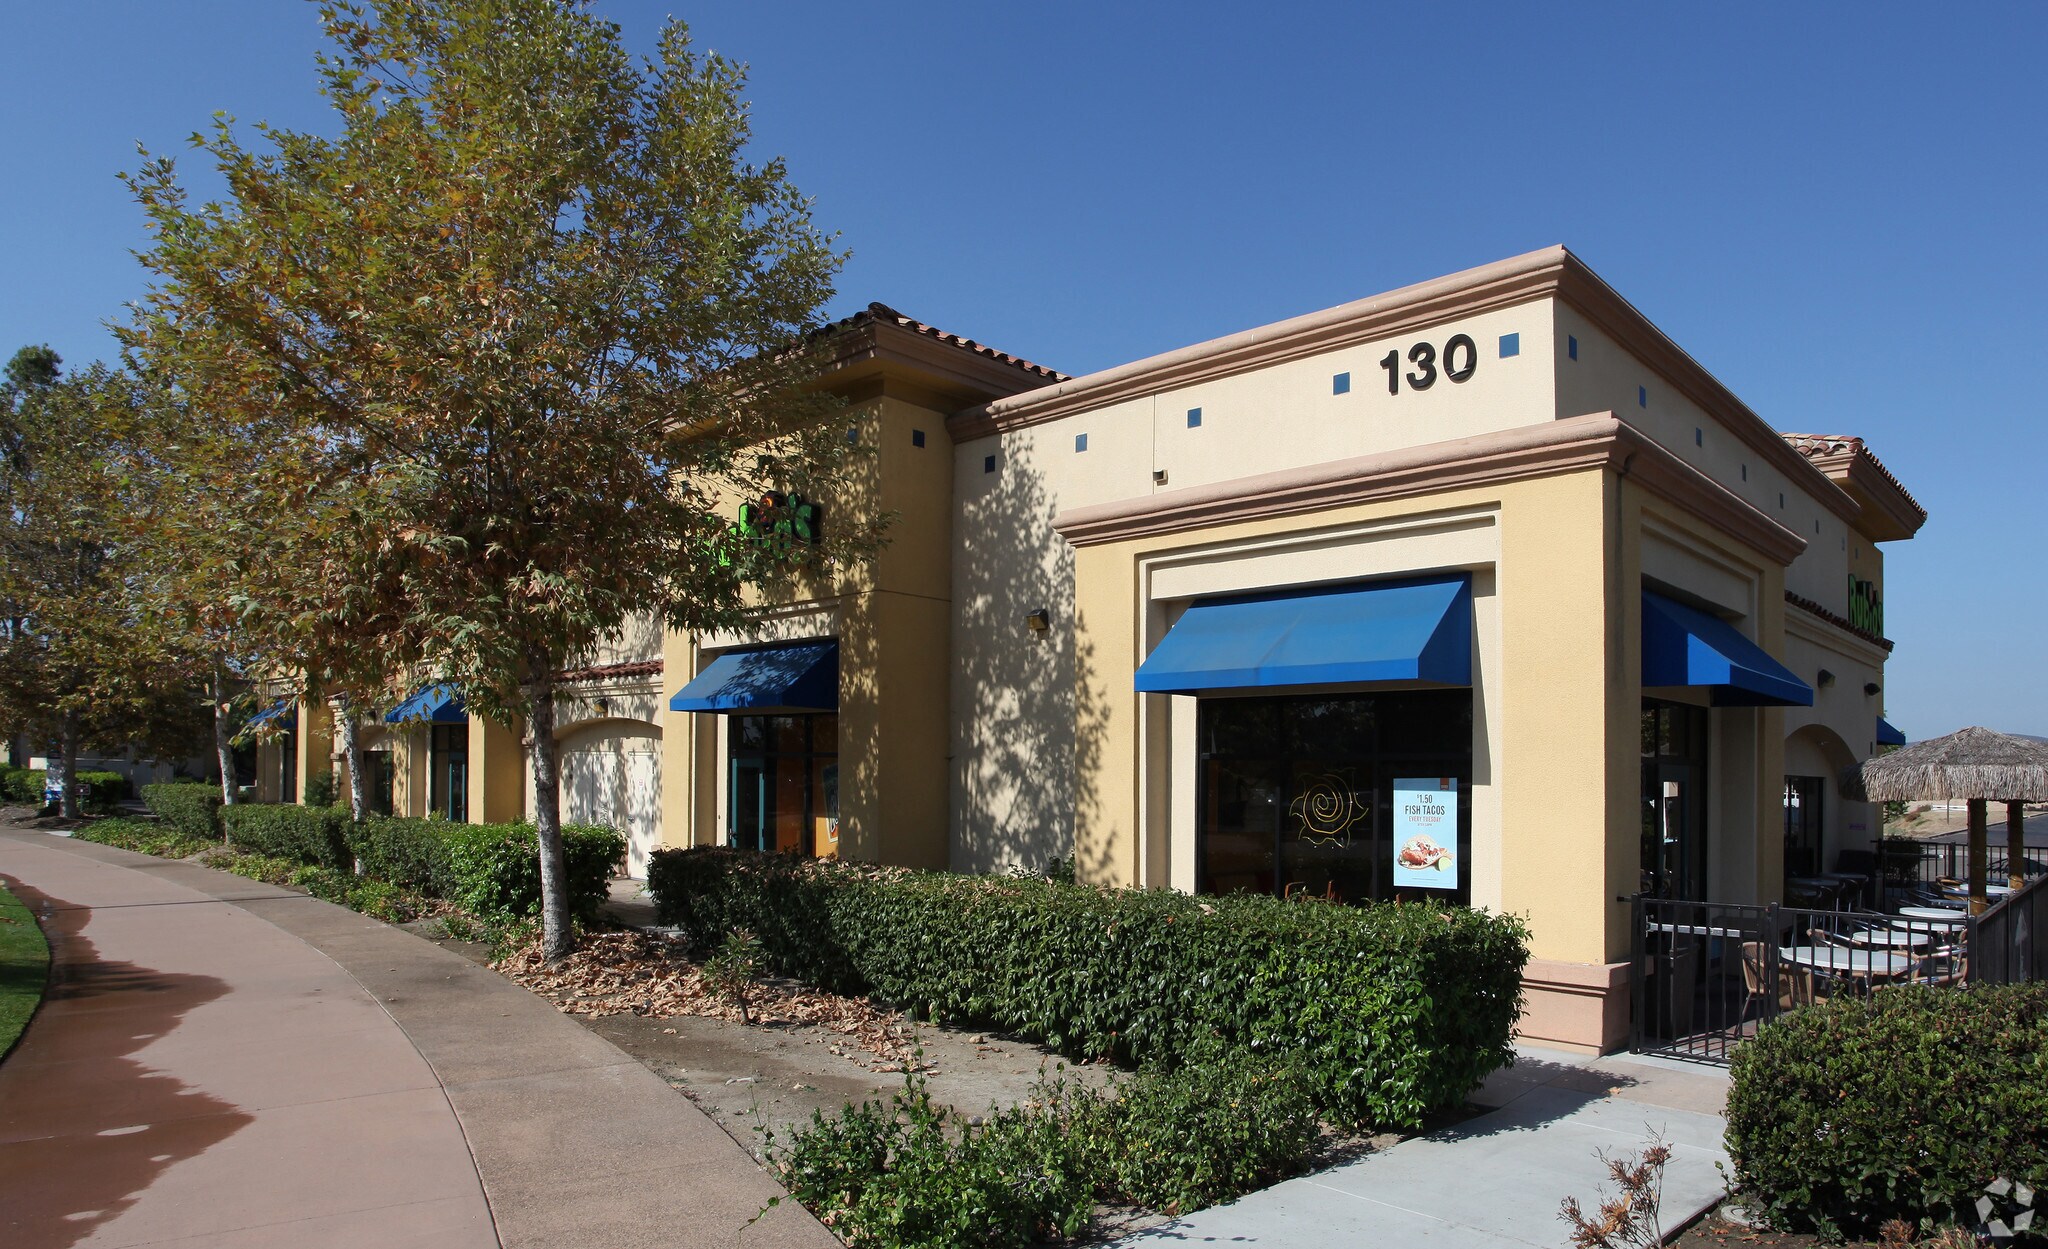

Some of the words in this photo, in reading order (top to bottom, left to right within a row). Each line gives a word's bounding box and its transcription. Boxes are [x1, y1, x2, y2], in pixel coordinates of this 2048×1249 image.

[1380, 333, 1477, 396] 130
[1417, 794, 1433, 804] $1.50
[1404, 805, 1421, 815] FISH
[1422, 805, 1446, 816] TACOS
